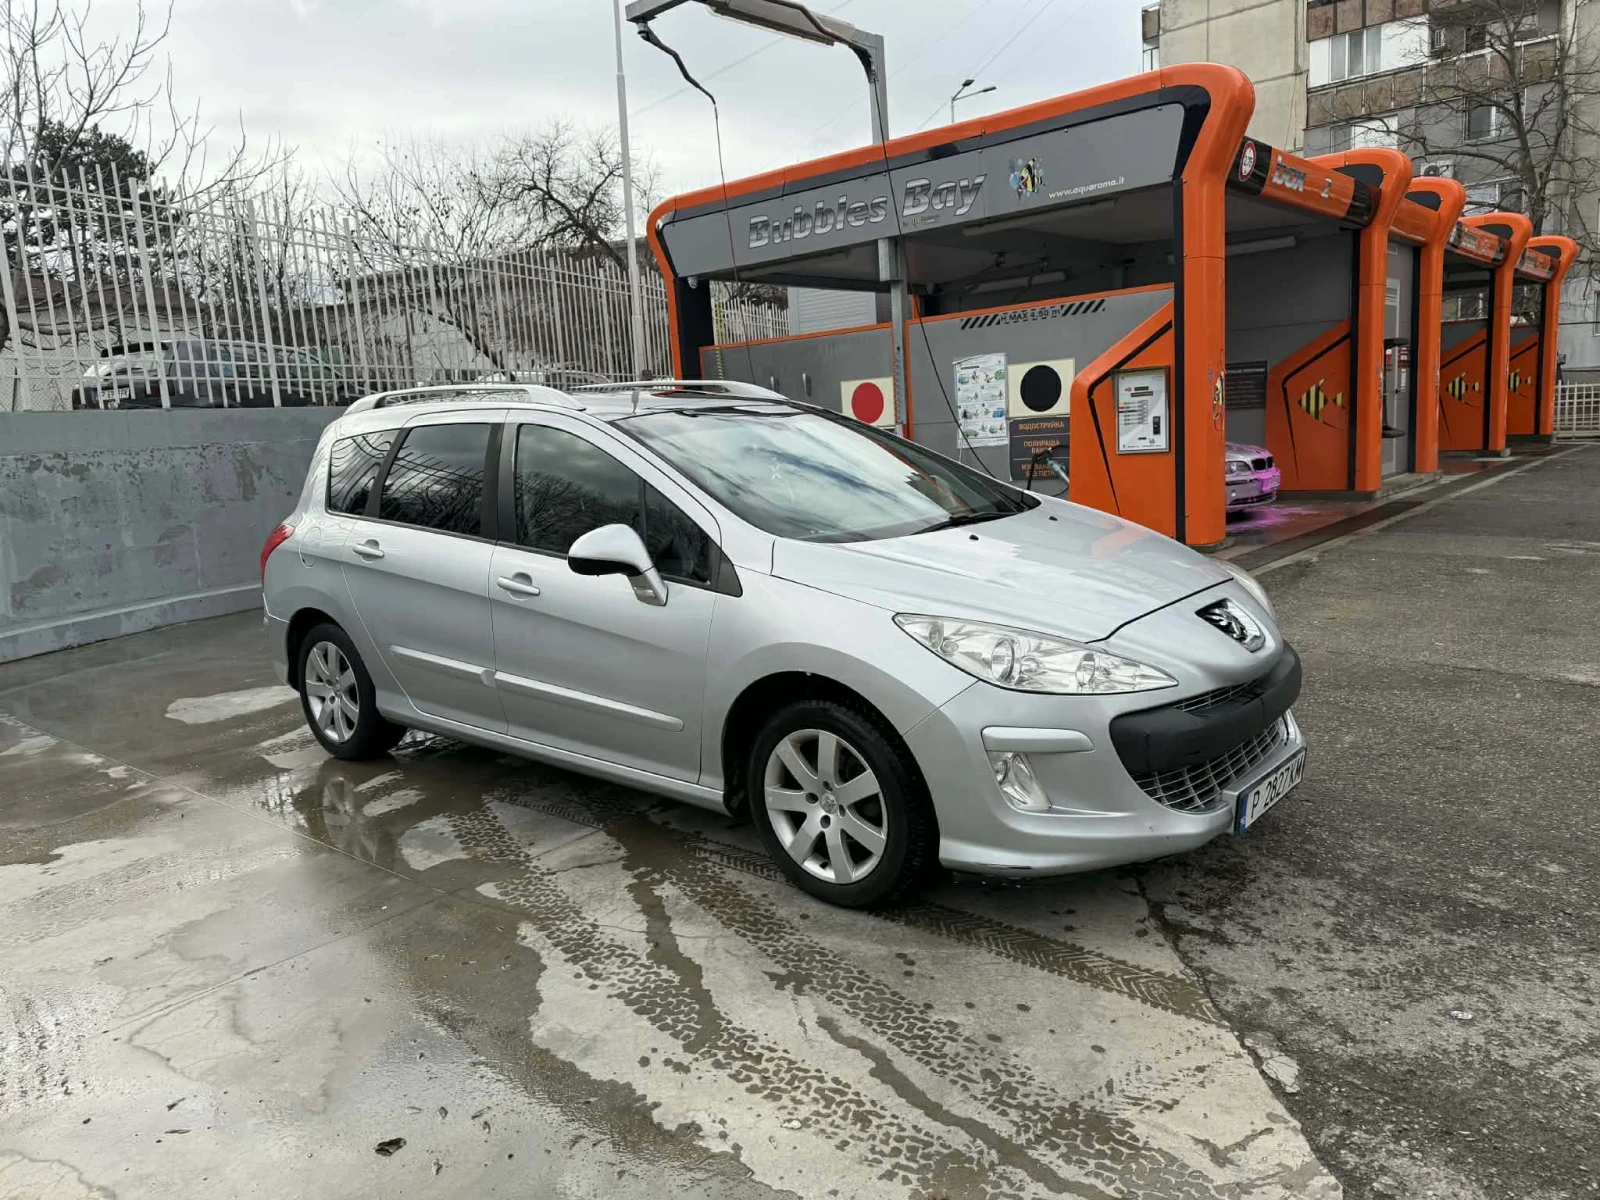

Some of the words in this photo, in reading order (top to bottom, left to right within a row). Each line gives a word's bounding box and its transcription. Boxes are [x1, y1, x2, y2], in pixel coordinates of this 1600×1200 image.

[1048, 176, 1125, 199] www.aquarama.it
[1321, 178, 1333, 198] 2
[749, 194, 888, 249] Bubbles
[902, 174, 988, 217] Bay
[1009, 312, 1028, 321] MAX
[1251, 790, 1260, 819] P
